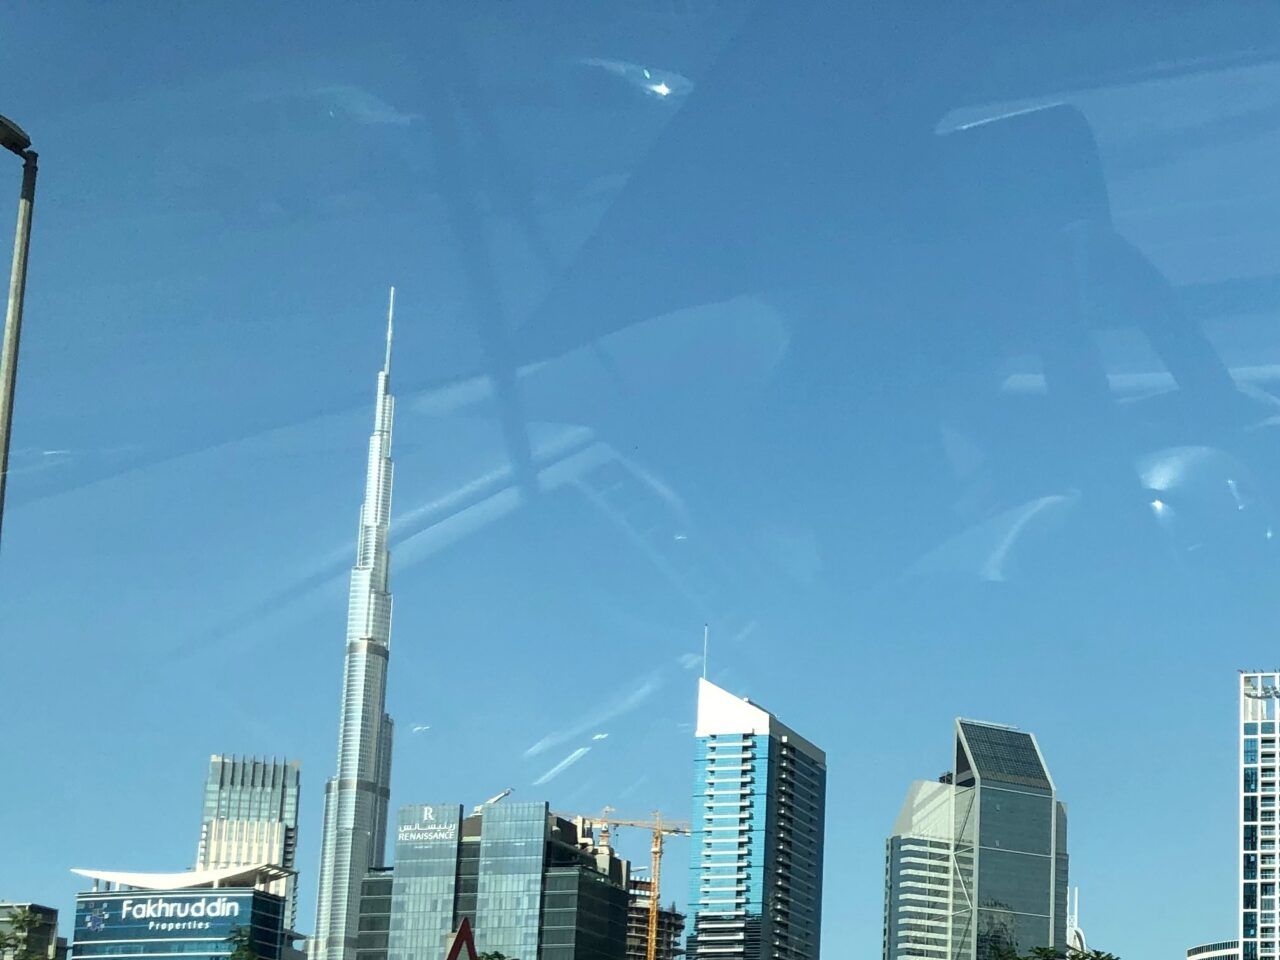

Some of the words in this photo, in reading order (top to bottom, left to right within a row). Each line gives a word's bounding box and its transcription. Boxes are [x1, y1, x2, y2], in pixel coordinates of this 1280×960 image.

[423, 806, 434, 821] R
[398, 831, 455, 841] RENAISSANCE
[121, 897, 239, 919] Fakhruddin
[148, 921, 211, 930] Properties
